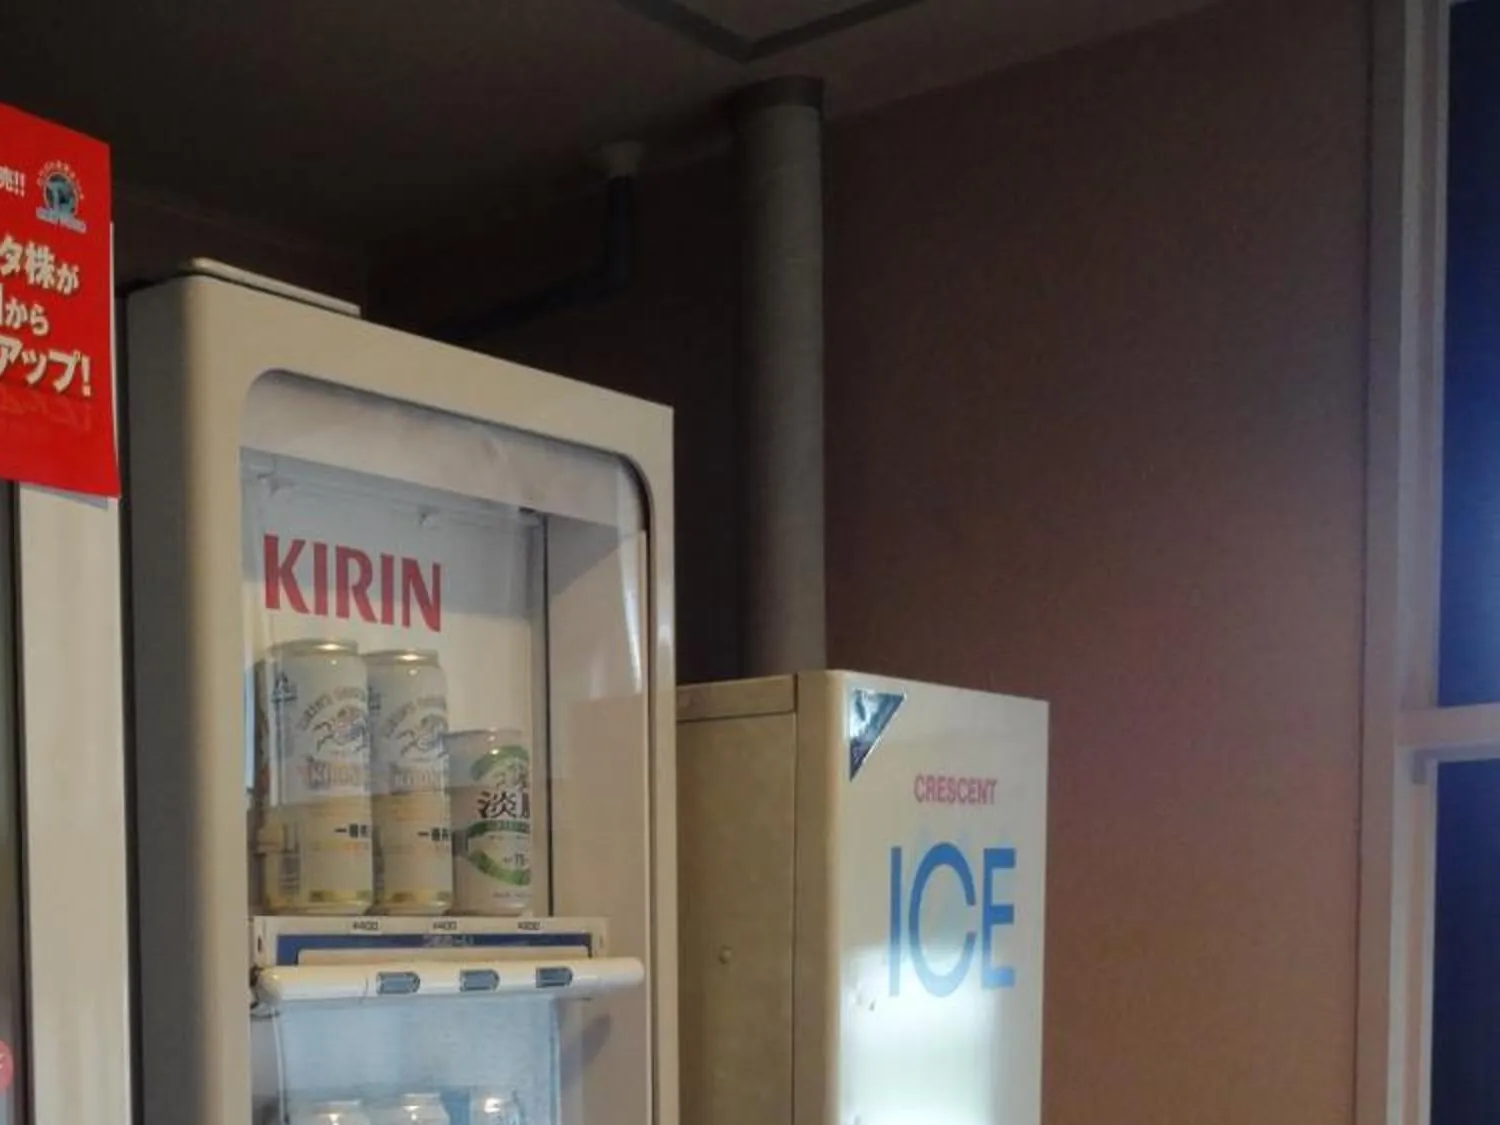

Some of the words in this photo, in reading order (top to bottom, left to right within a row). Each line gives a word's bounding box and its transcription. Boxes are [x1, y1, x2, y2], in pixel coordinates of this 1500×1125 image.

[263, 533, 442, 633] KIRIN
[913, 773, 999, 806] CRESCENT
[888, 841, 1017, 998] ICE
